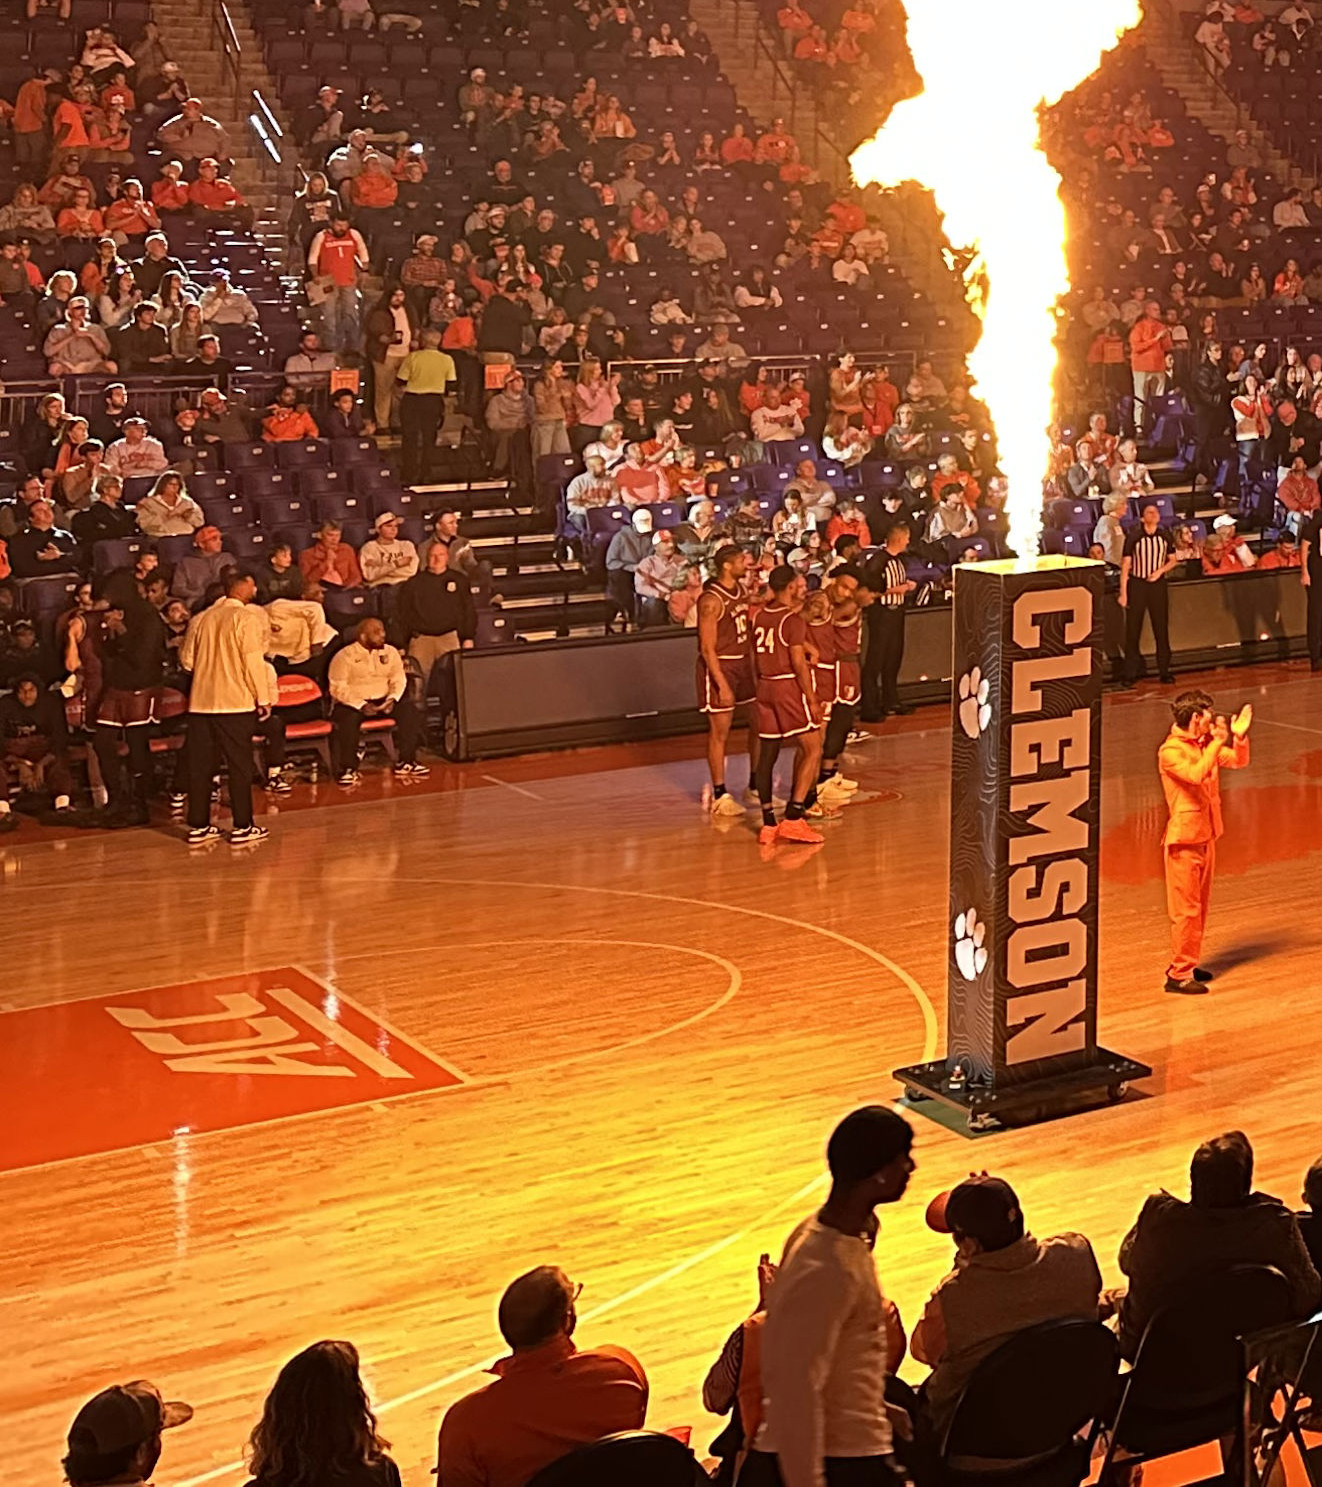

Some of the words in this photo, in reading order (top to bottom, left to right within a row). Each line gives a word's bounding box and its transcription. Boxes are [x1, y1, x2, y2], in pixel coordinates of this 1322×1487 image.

[755, 626, 775, 655] 24
[1006, 585, 1093, 1066] CLEMSON
[104, 990, 359, 1078] ACC
